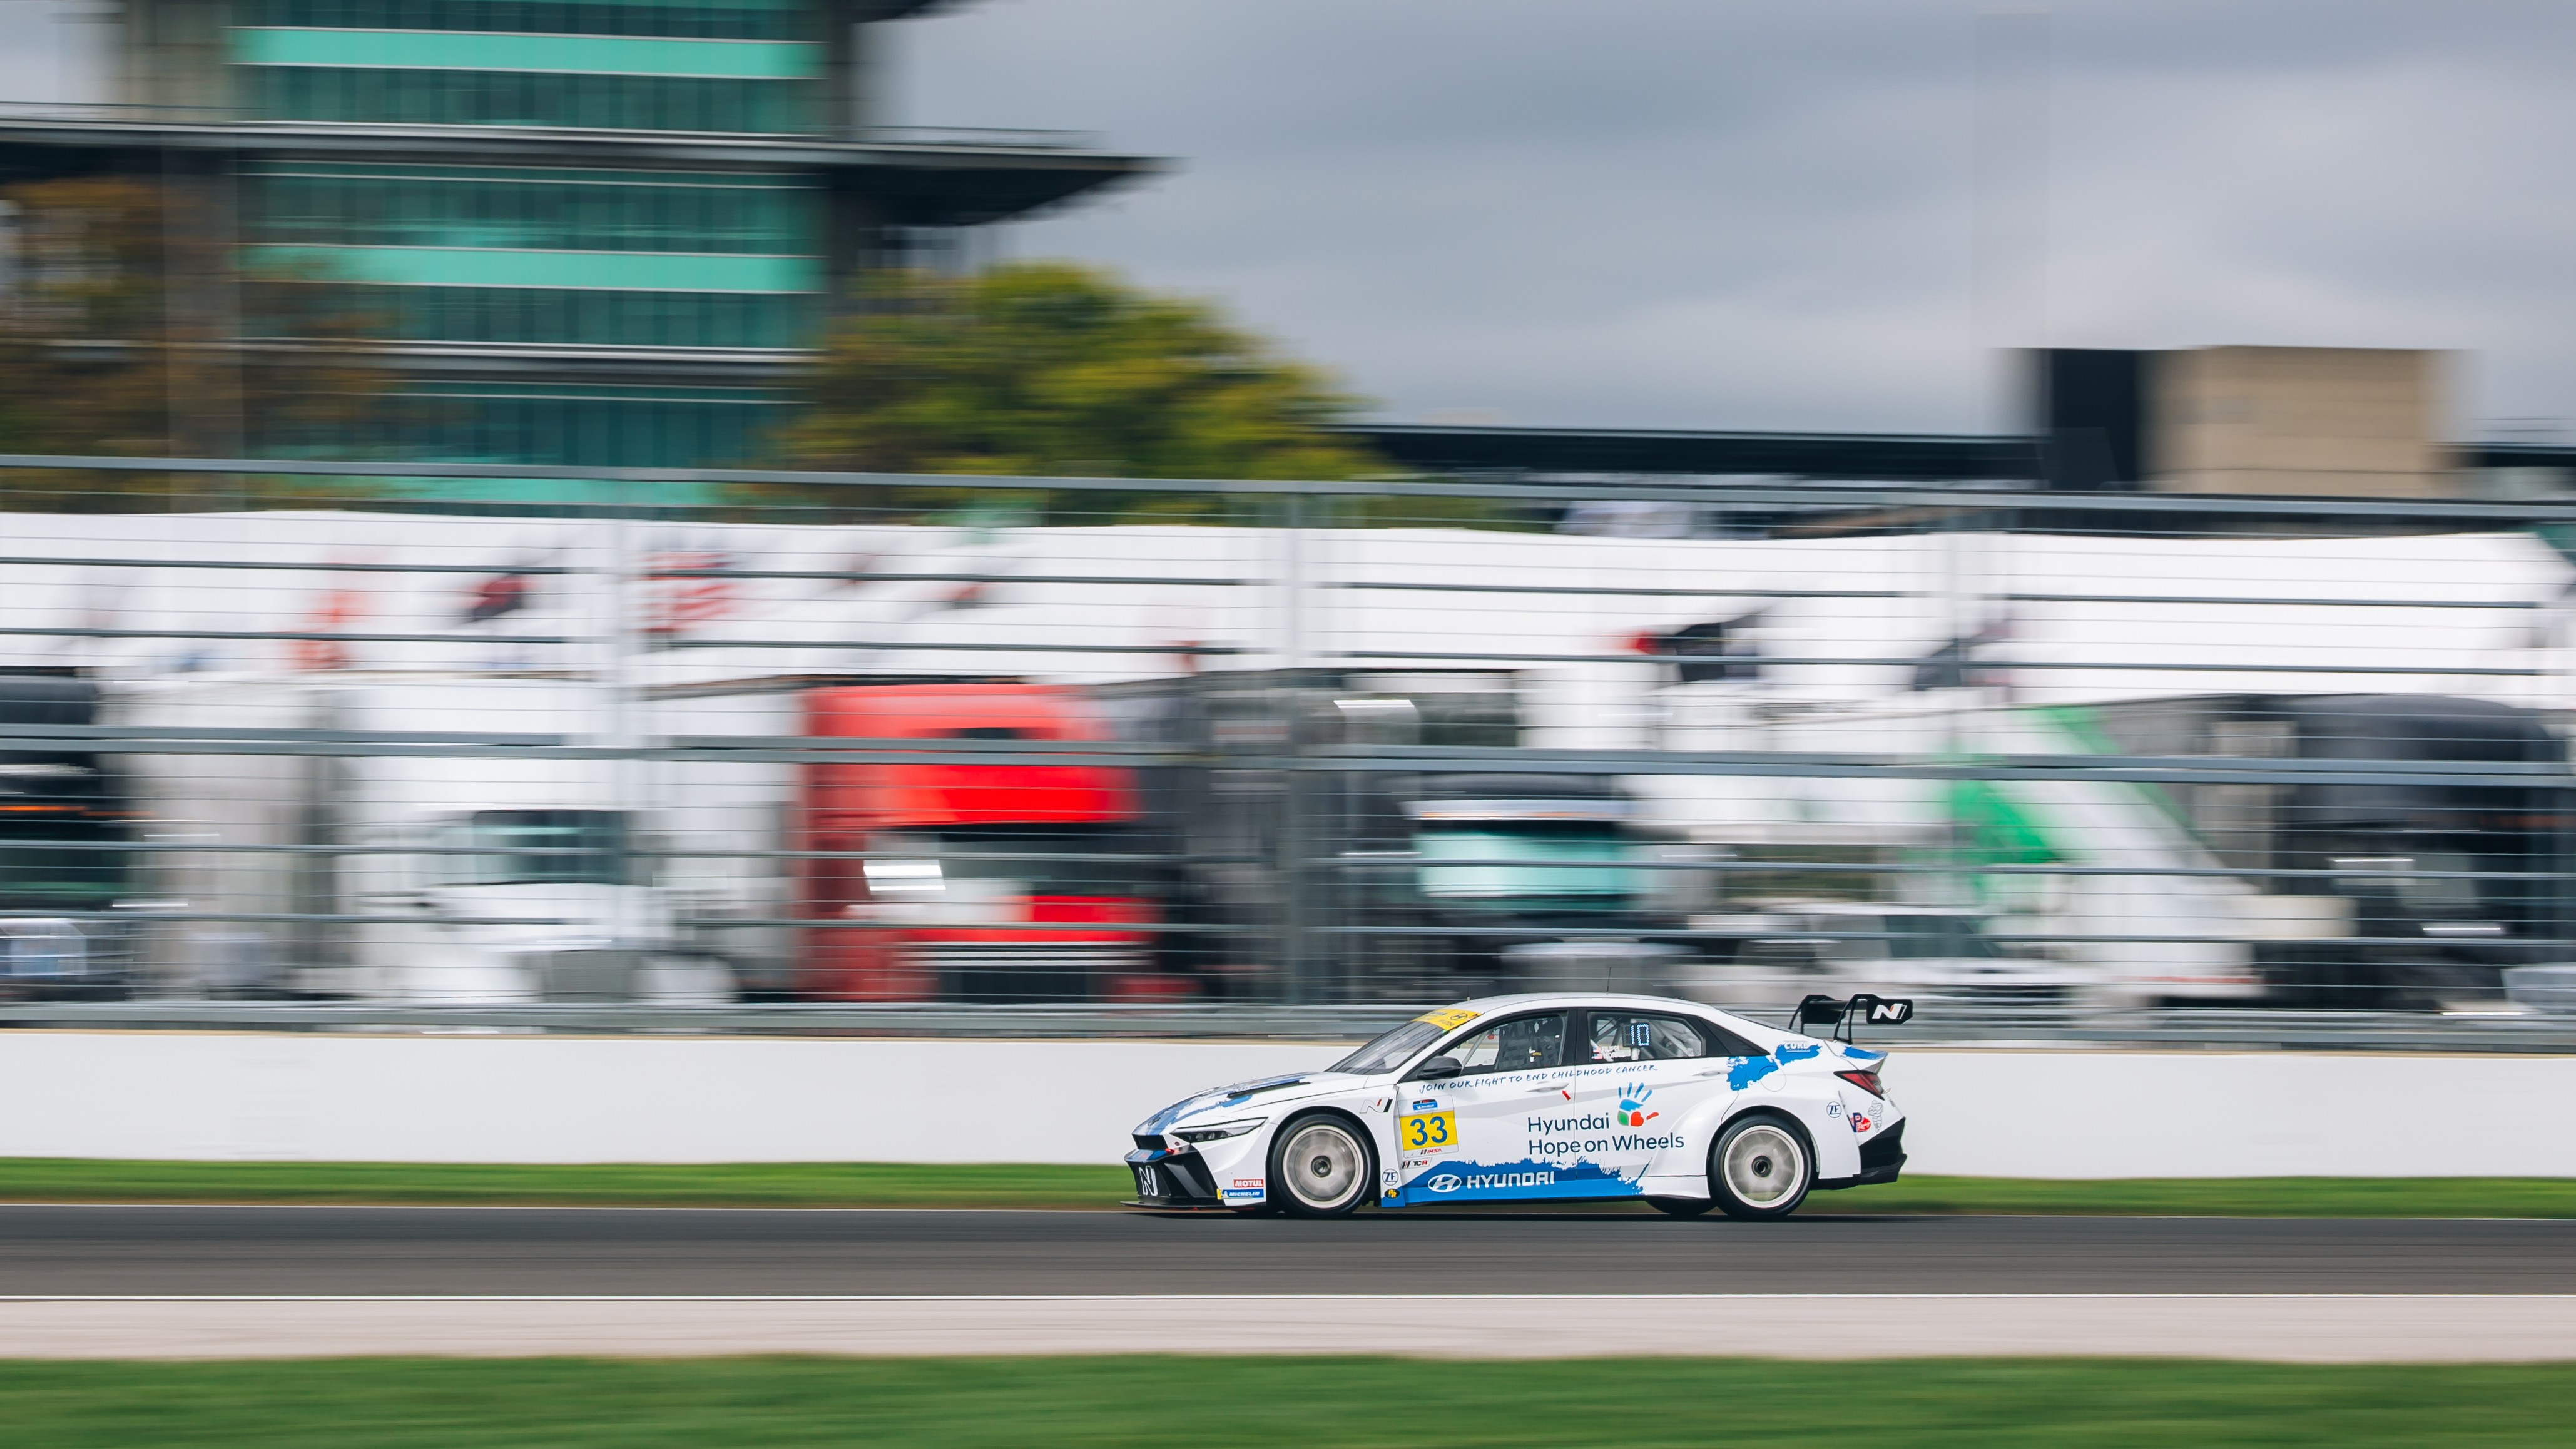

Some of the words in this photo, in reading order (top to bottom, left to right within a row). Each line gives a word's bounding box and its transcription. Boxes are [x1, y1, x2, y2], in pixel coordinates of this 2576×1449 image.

[1631, 1024, 1650, 1046] 10
[1419, 1083, 1447, 1094] JOIN
[1449, 1080, 1473, 1089] OUR
[1475, 1077, 1506, 1087] FIGHT
[1526, 1073, 1548, 1082] END
[1552, 1067, 1612, 1079] CHILDHOOD
[1616, 1065, 1658, 1073] CANCER
[1827, 1105, 1841, 1114] ZF
[1410, 1116, 1448, 1146] 33
[1527, 1112, 1610, 1136] Hyundai
[1529, 1139, 1581, 1157] Hope
[1584, 1139, 1609, 1152] on
[1612, 1132, 1685, 1151] Wheels
[1383, 1172, 1398, 1182] ZF
[1467, 1171, 1555, 1189] HYUNDAI
